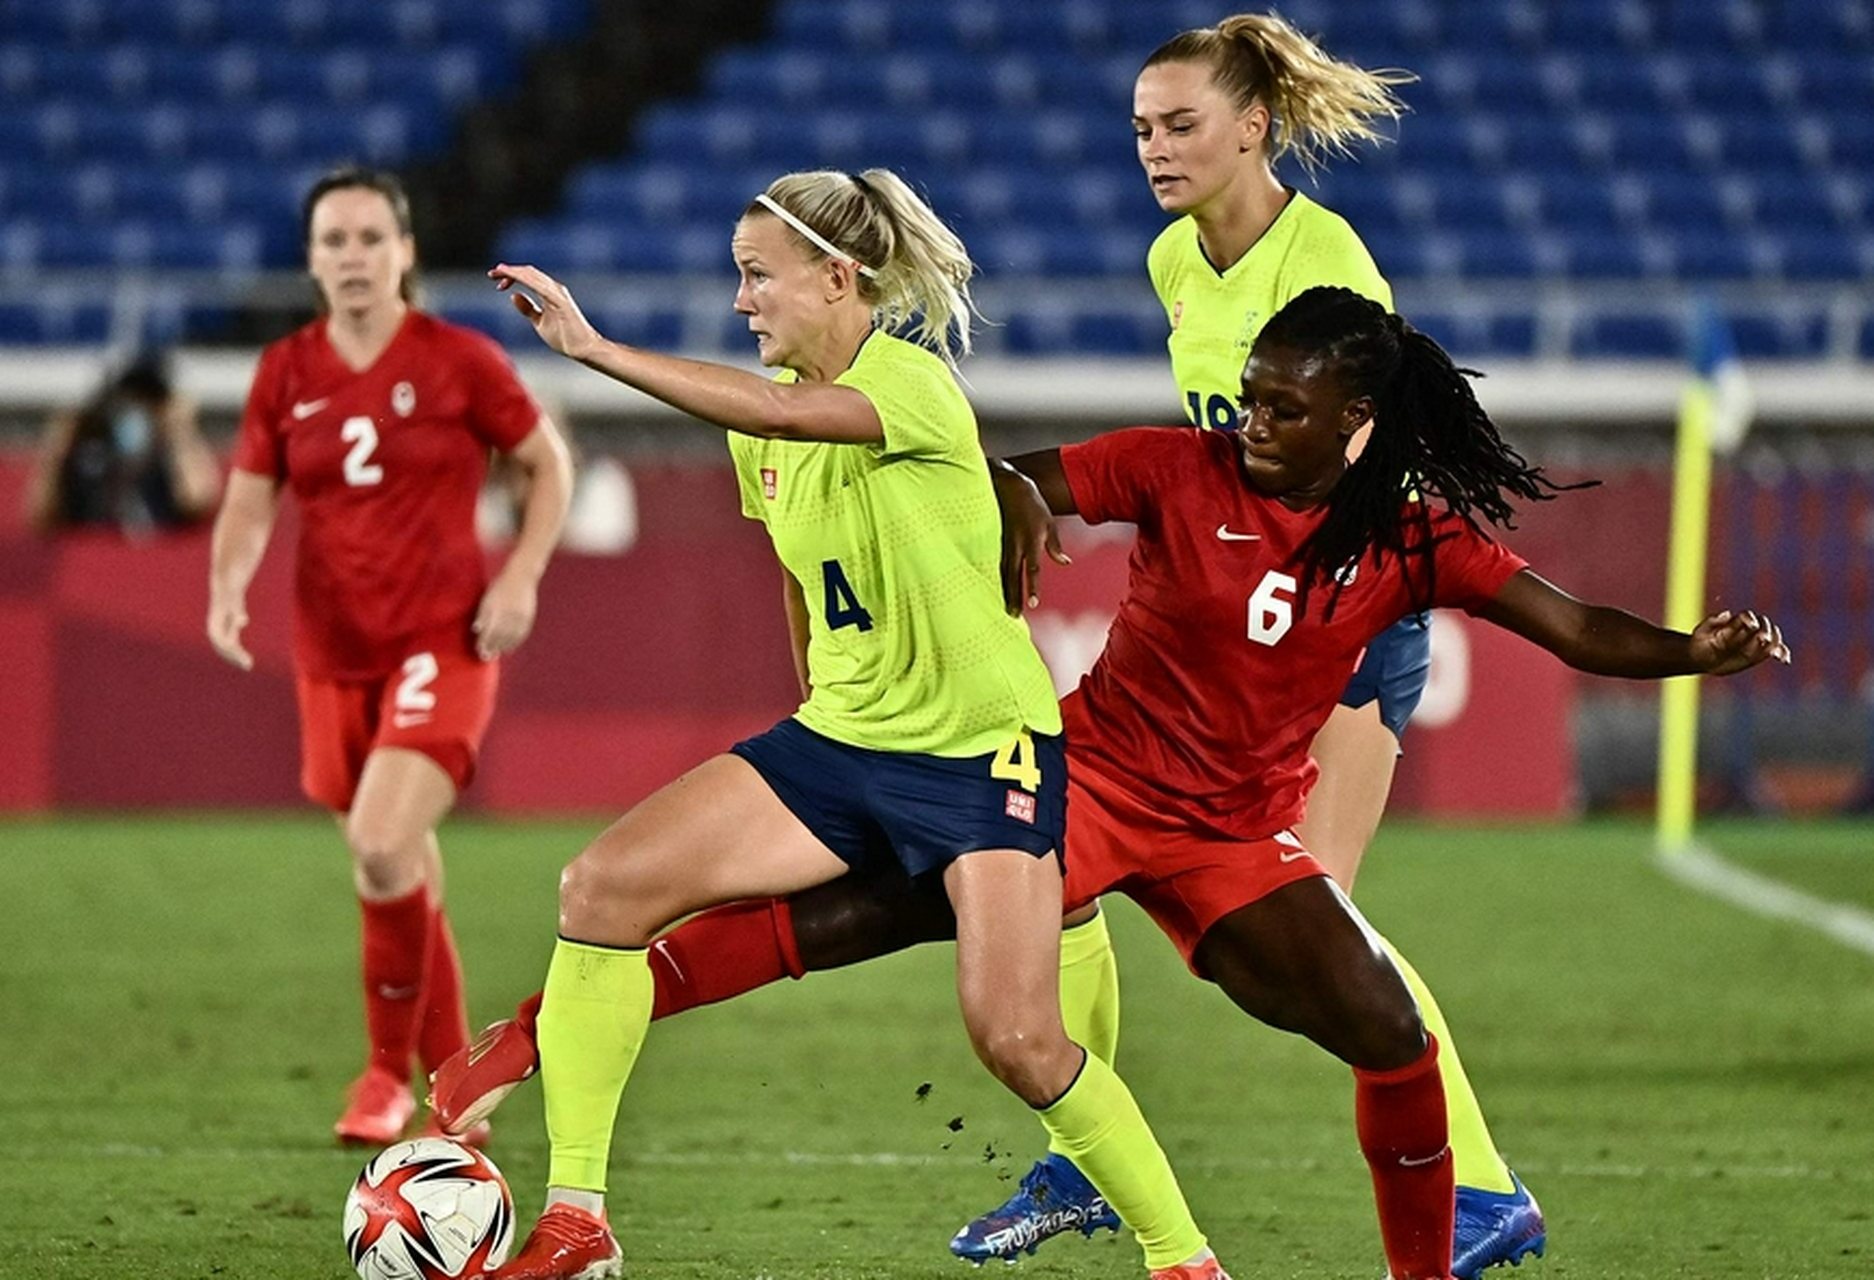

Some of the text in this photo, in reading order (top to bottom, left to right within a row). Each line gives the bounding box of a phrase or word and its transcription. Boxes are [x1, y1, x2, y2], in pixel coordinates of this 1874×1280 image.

[340, 415, 383, 488] 2
[822, 559, 873, 632] 4
[1248, 569, 1296, 647] 6
[395, 651, 438, 711] 2
[991, 725, 1041, 793] 4
